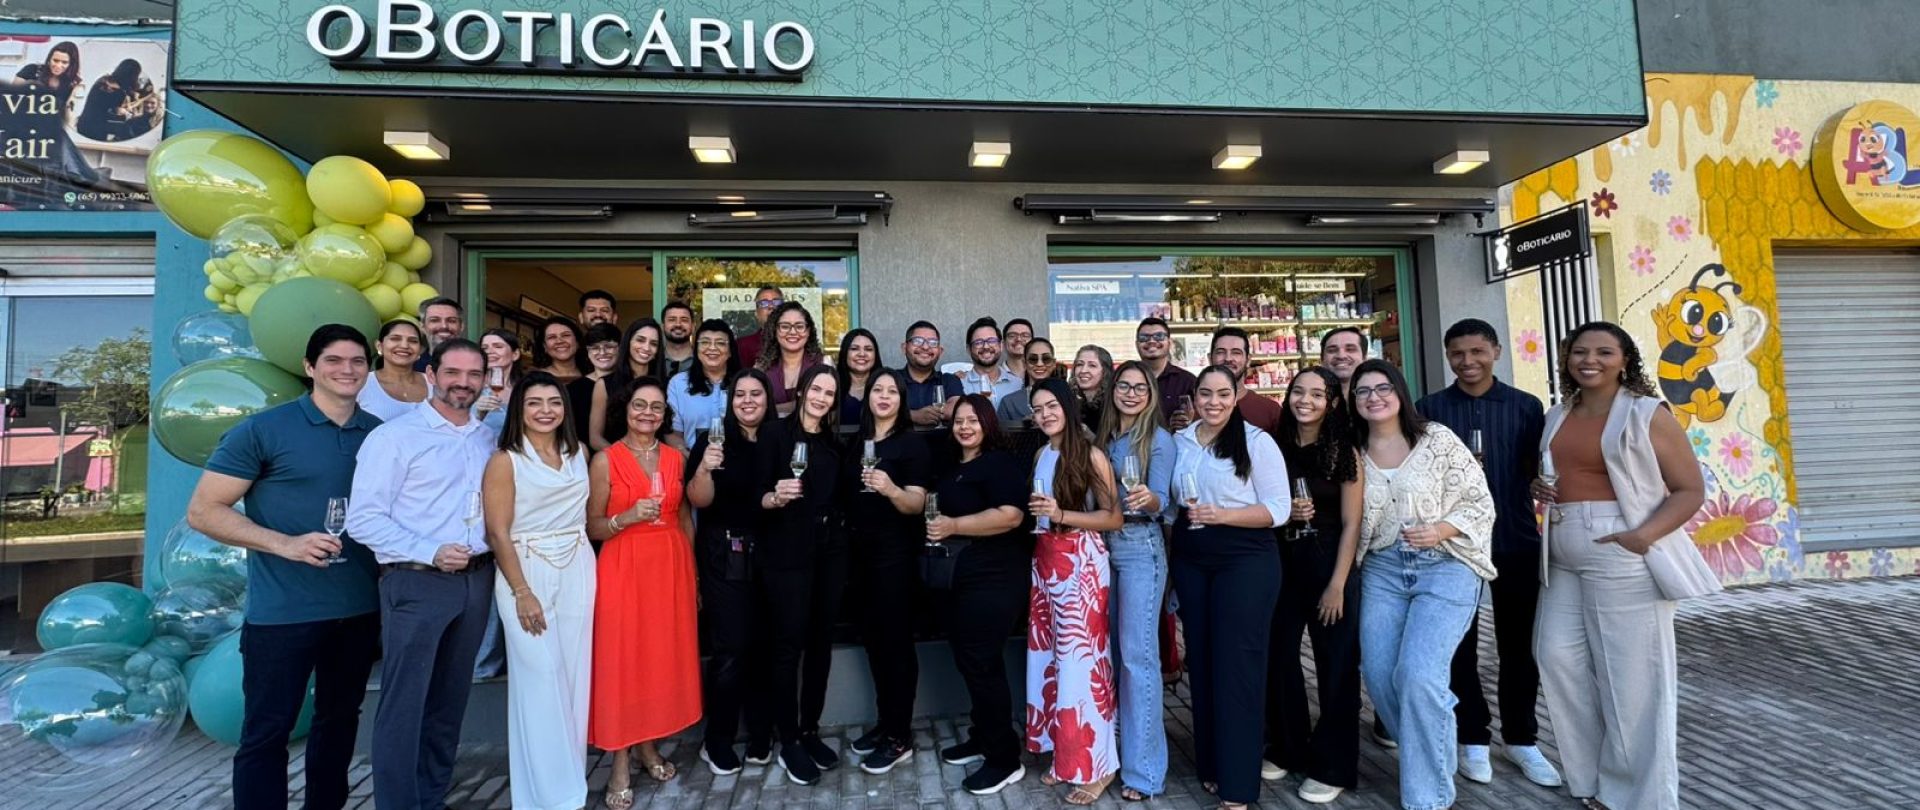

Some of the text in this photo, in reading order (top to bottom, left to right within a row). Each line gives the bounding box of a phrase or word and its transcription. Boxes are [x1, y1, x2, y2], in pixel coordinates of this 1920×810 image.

[0, 84, 59, 115] via
[0, 129, 55, 159] air
[719, 293, 740, 303] DIA
